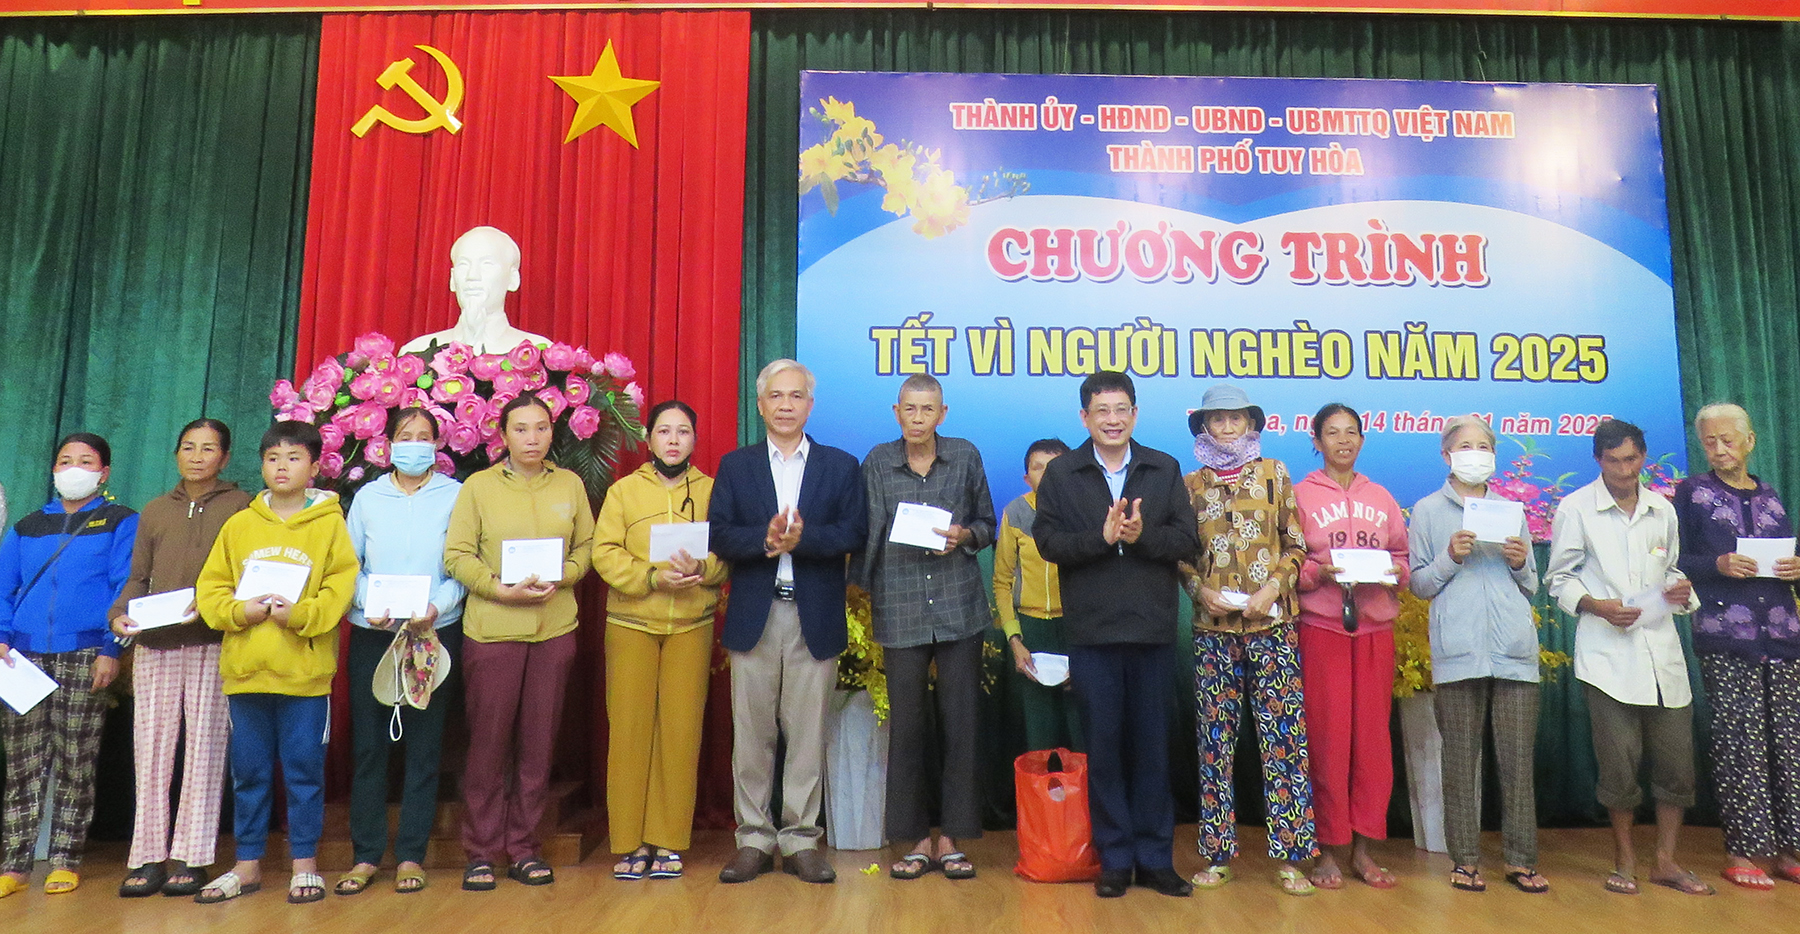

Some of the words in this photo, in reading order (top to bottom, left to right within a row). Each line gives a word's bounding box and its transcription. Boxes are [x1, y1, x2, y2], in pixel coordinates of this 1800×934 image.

[951, 98, 1037, 130] THÀNH
[1042, 97, 1077, 130] ỦY
[1099, 105, 1171, 132] HĐND
[1192, 106, 1265, 133] UBND
[1286, 107, 1390, 138] UBMTTQ
[1393, 105, 1449, 142] VIỆT
[1453, 110, 1515, 138] NAM
[1107, 140, 1194, 172] THÀNH
[1199, 138, 1253, 174] PHỐ
[1255, 147, 1305, 174] TUY
[1309, 142, 1364, 175] HÒA
[986, 219, 1266, 283] CHƯƠNG
[1280, 218, 1488, 286] TRÌNH
[869, 312, 955, 376] TẾT
[966, 317, 1015, 376] VÌ
[1028, 317, 1178, 377] NGƯỜI
[1190, 320, 1353, 379] NGHÈO
[1365, 322, 1479, 380] NĂM
[1490, 333, 1608, 383] 2025
[1361, 411, 1386, 432] 14
[1393, 411, 1456, 433] thán
[1501, 412, 1551, 434] năm
[1557, 414, 1613, 436] 202
[1353, 501, 1388, 528] NOT
